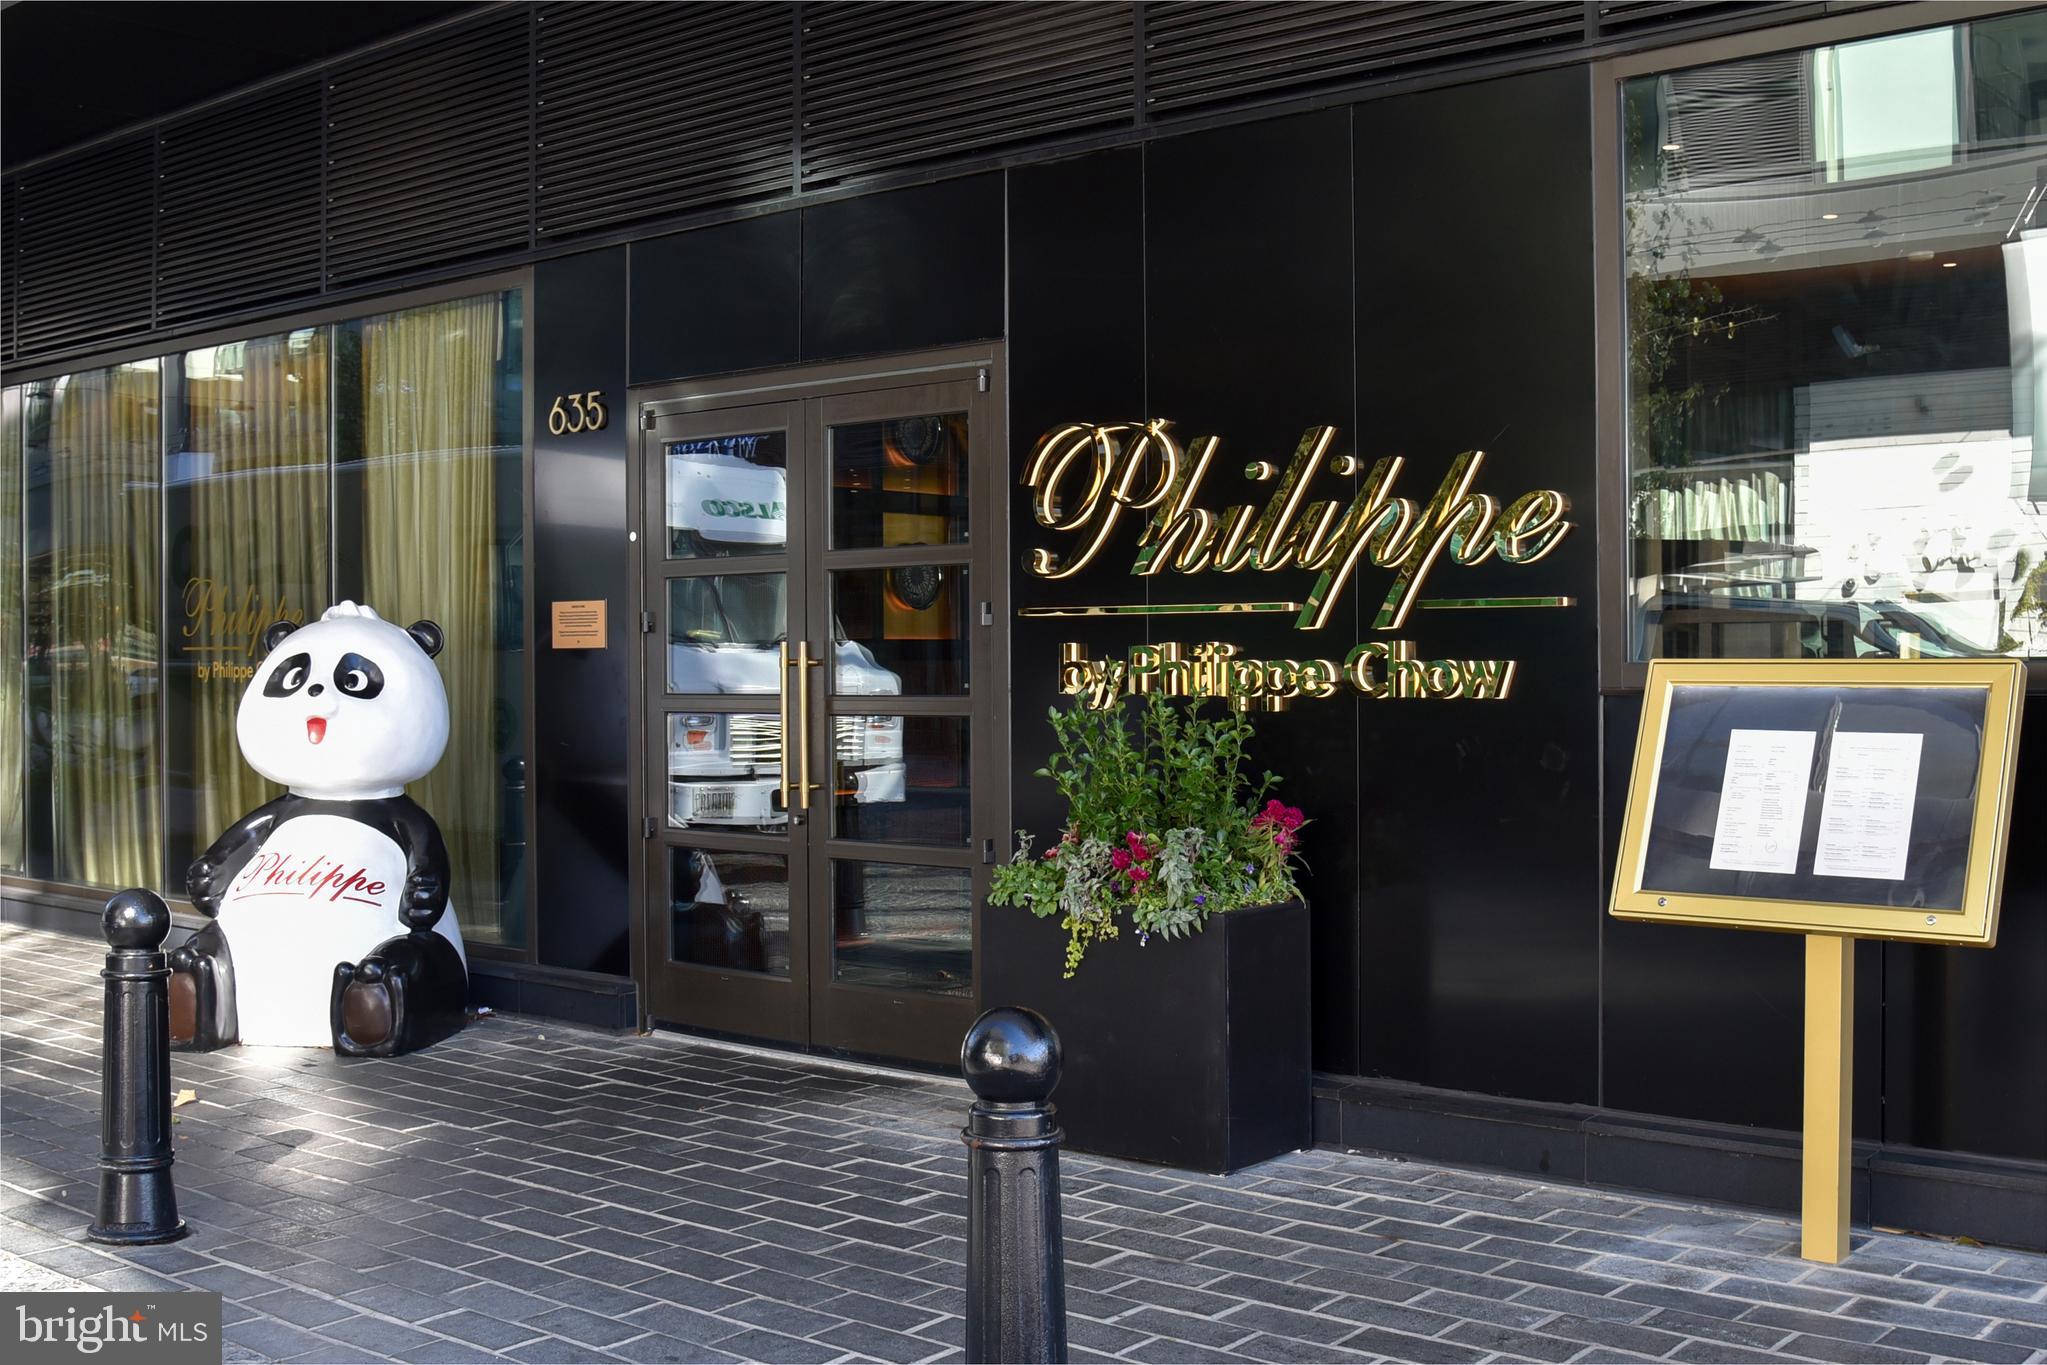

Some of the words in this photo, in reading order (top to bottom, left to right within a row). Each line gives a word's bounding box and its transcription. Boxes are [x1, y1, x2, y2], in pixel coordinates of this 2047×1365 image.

[549, 391, 605, 435] 635
[1020, 418, 1577, 629] Philippe
[197, 660, 210, 683] by
[212, 660, 253, 683] Philippe
[1058, 641, 1125, 710] by
[1128, 641, 1338, 712] Philippe
[1342, 640, 1518, 699] Chow
[236, 852, 386, 902] Philippe
